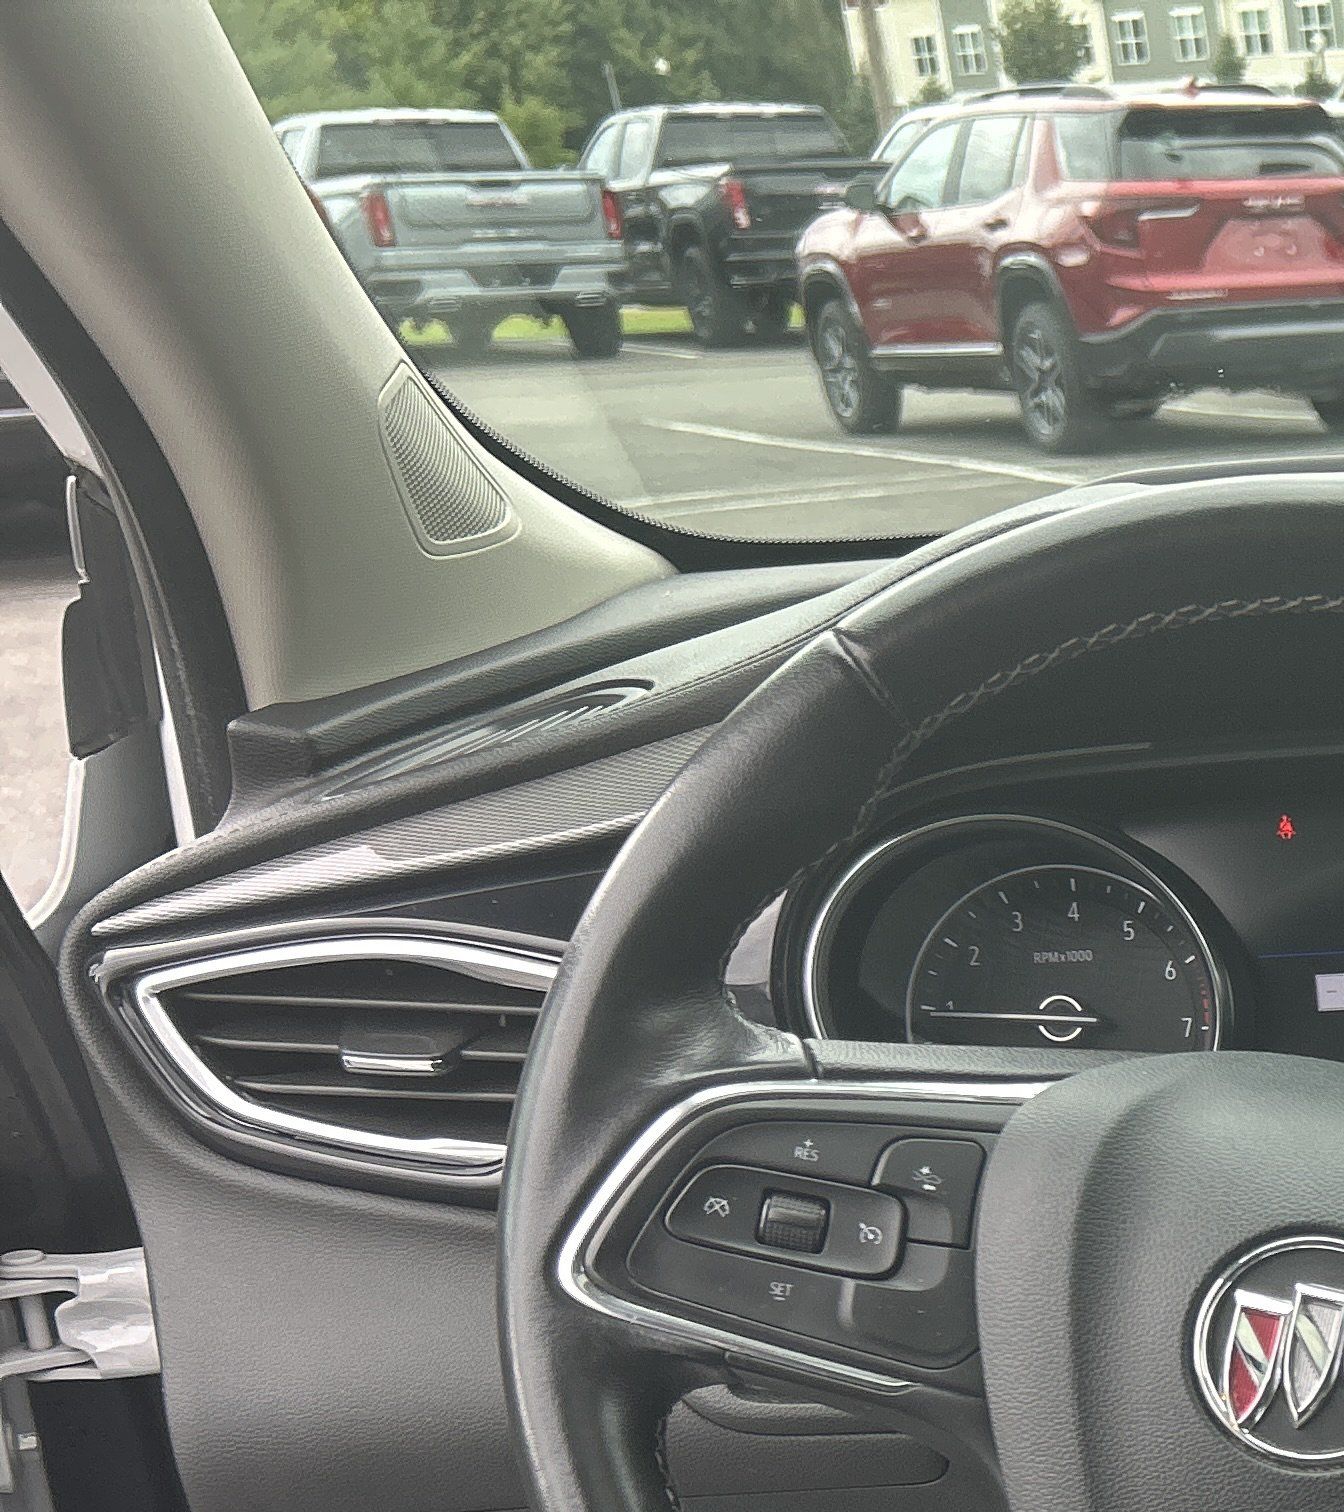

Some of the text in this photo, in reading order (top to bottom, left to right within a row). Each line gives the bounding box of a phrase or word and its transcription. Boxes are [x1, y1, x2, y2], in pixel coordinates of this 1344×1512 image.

[1012, 912, 1024, 932] 3
[1067, 901, 1081, 922] 4
[1122, 920, 1135, 941] 5
[969, 946, 981, 967] 2
[1164, 959, 1177, 981] 6
[1181, 1017, 1193, 1038] 7
[794, 1146, 820, 1162] RES
[768, 1281, 795, 1296] SET
